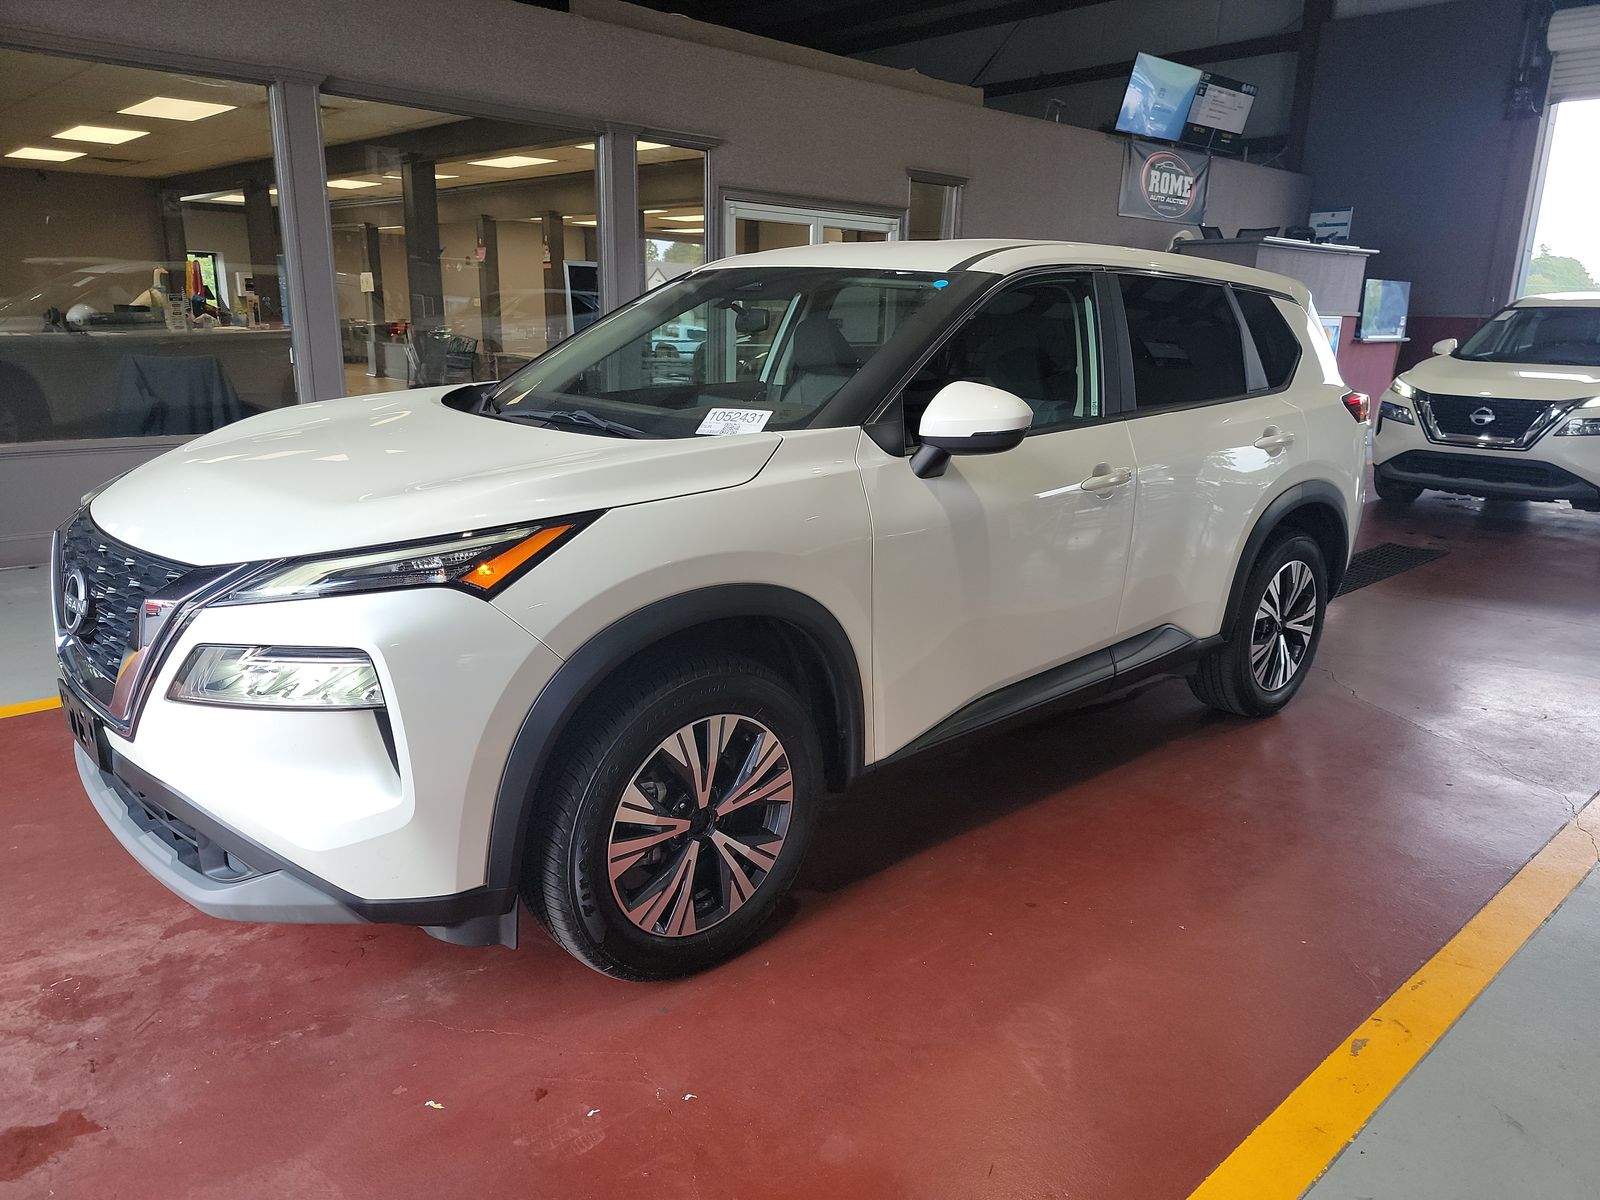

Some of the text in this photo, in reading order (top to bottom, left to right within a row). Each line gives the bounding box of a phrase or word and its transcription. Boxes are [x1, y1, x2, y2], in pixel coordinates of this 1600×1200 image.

[1148, 170, 1193, 198] ROME
[1150, 194, 1188, 206] AUTO AUCTION
[710, 411, 764, 424] 1052431
[65, 594, 86, 614] SSAN
